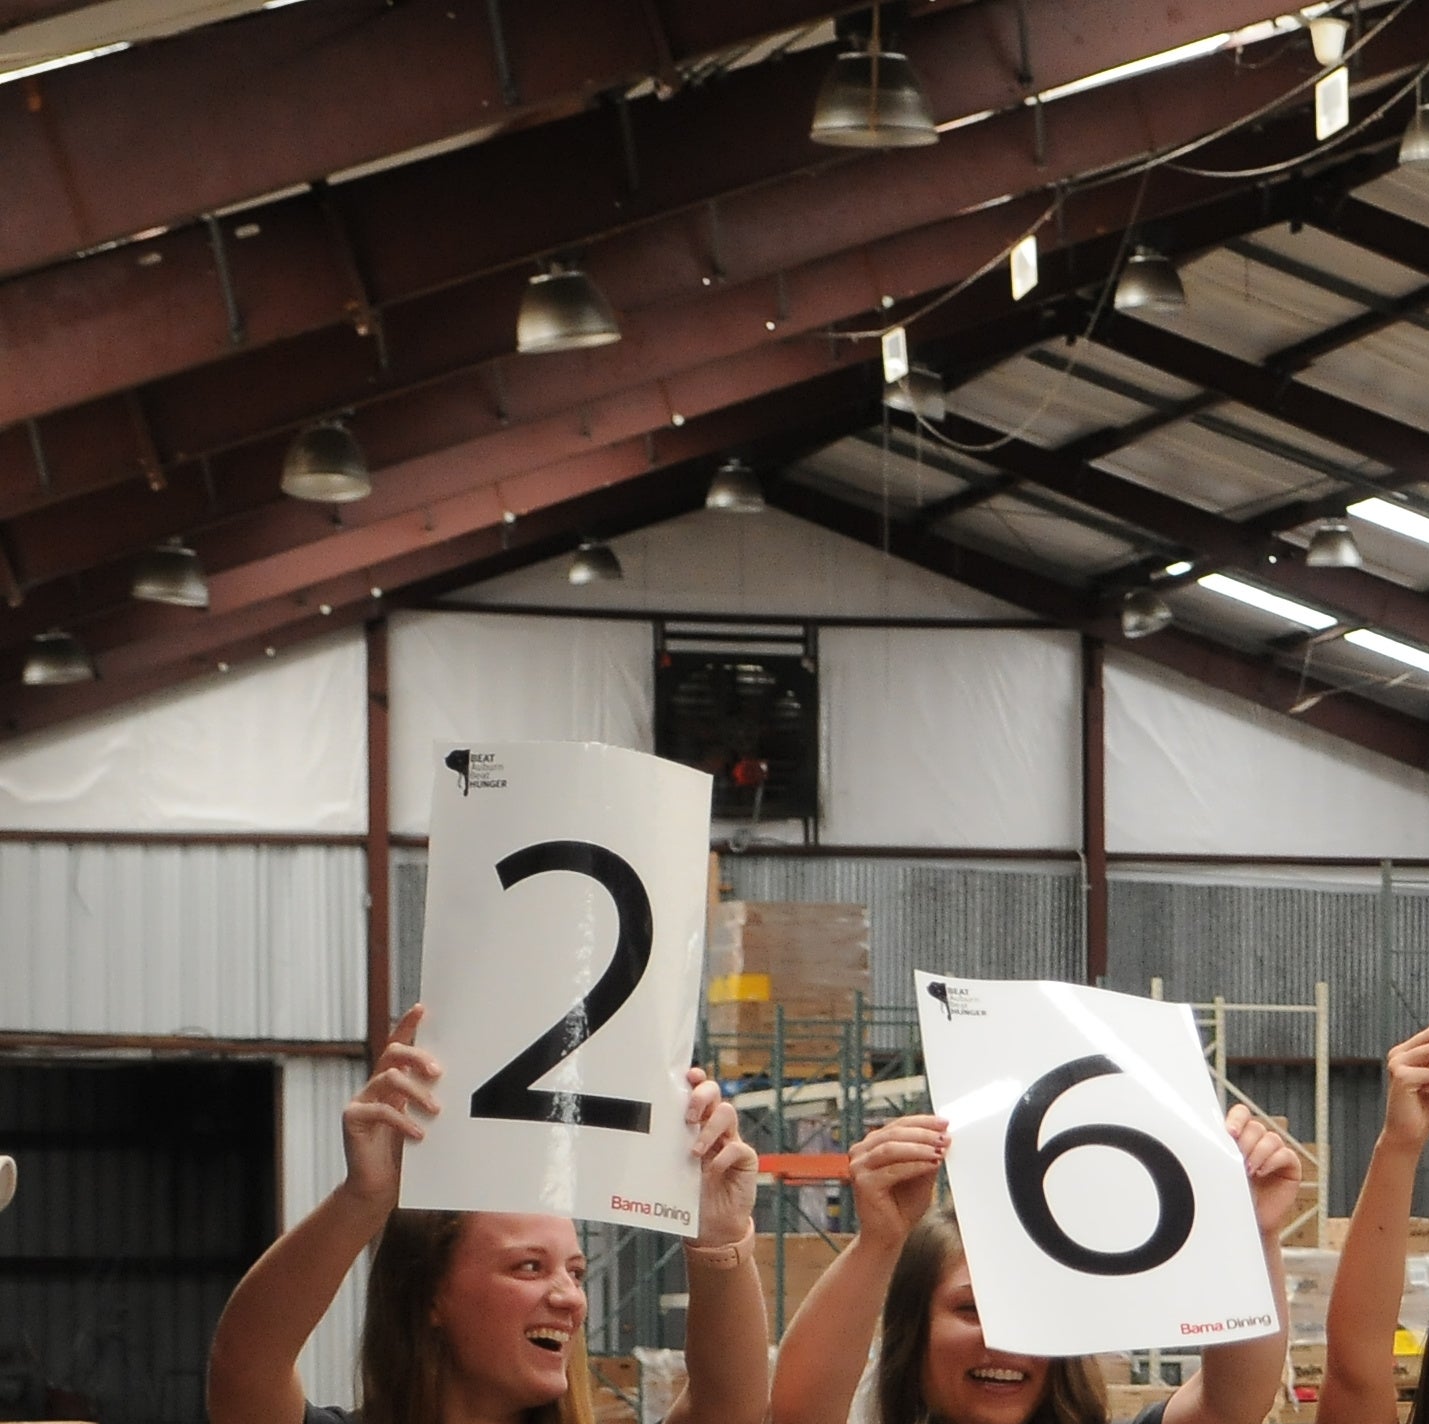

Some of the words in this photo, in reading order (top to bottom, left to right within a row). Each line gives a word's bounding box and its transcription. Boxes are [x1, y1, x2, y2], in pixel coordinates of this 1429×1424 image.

[471, 753, 495, 762] BEAT
[470, 780, 507, 788] HUNGER
[470, 840, 653, 1134] 2
[1005, 1058, 1194, 1275] 6
[611, 1195, 651, 1215] Bama
[654, 1202, 691, 1226] Dining
[1180, 1322, 1223, 1335] Bama
[1226, 1314, 1272, 1330] Dining
